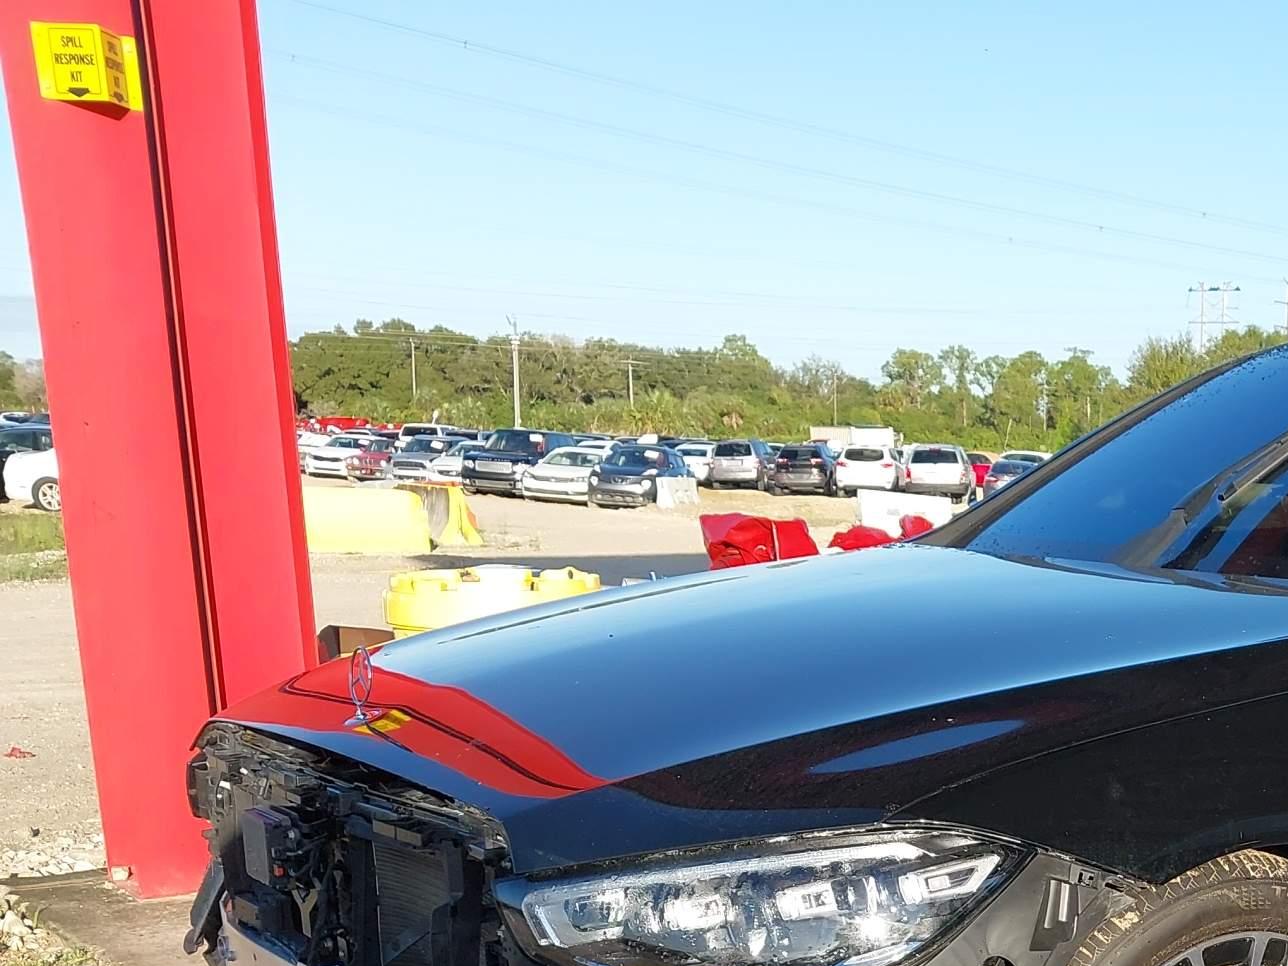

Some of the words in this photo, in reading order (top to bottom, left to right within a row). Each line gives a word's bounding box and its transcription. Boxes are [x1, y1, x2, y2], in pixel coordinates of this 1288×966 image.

[60, 35, 84, 48] SPILL
[53, 53, 96, 65] RESPONSE
[70, 70, 83, 82] KIT
